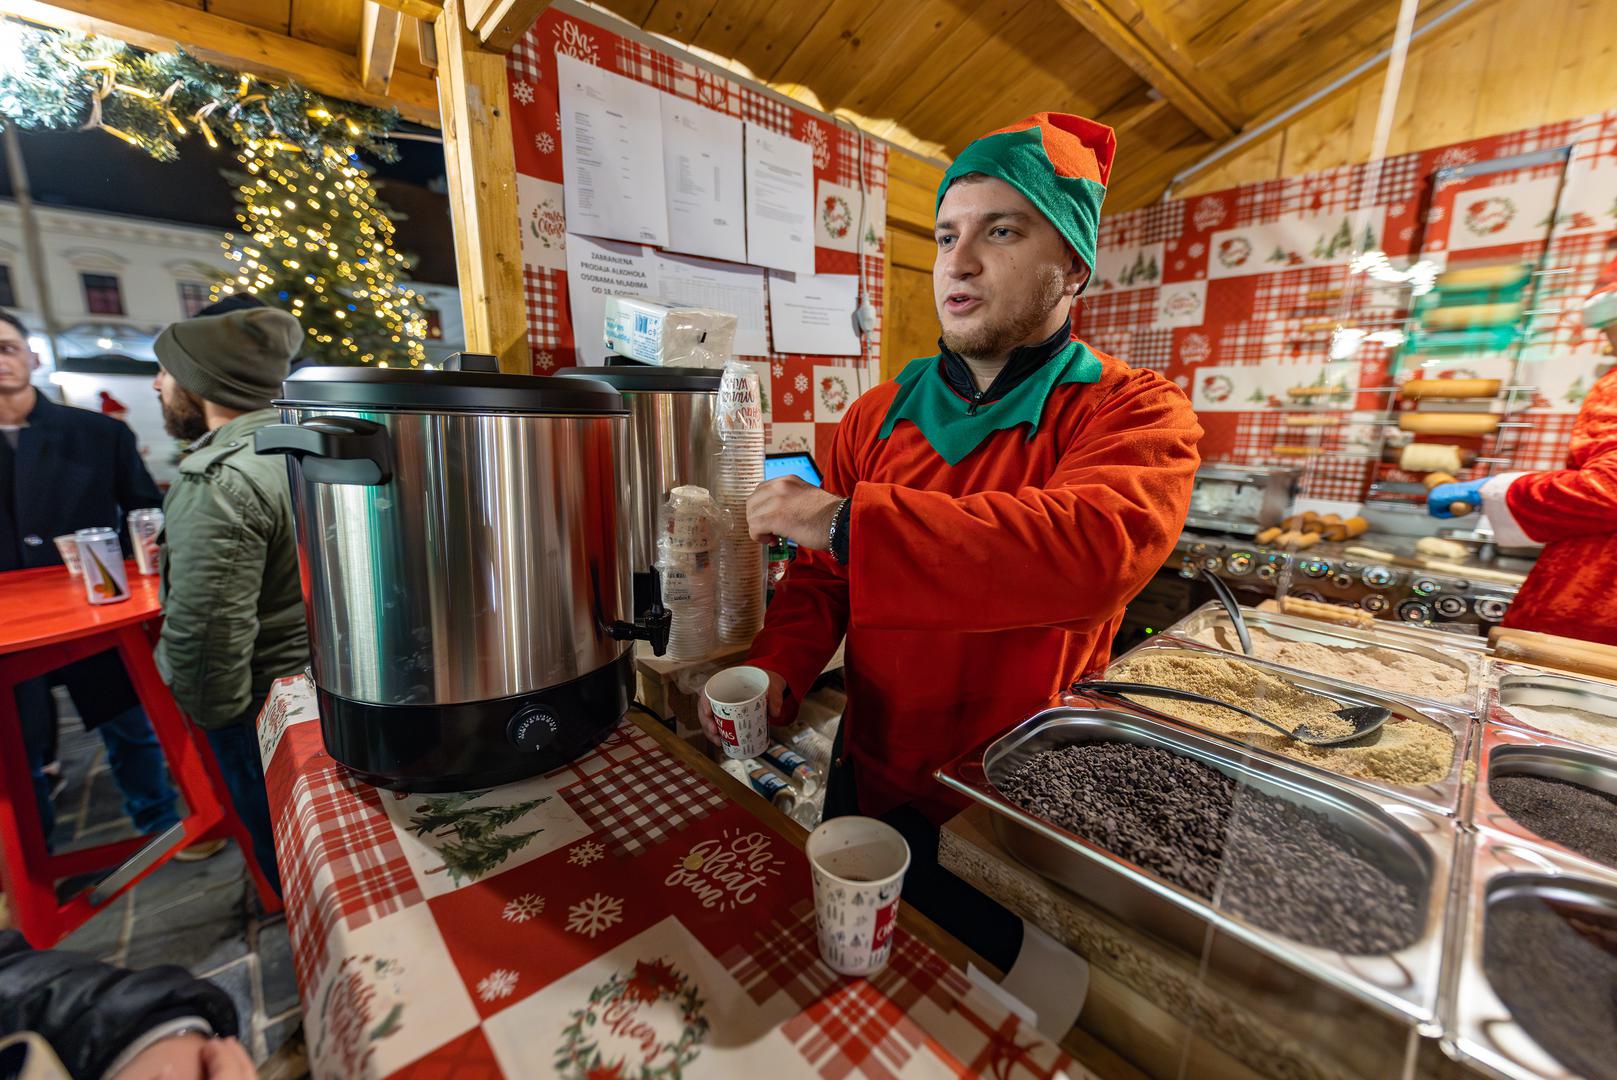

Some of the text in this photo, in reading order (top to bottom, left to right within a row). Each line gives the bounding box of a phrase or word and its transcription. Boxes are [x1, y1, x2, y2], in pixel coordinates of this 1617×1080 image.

[580, 261, 646, 278] PRODAJA ALKOHOLA
[591, 252, 633, 266] ZABRANJENA
[580, 273, 615, 285] OSOBAMA
[731, 831, 774, 872] Oh
[687, 839, 767, 905] What
[664, 867, 724, 908] fun
